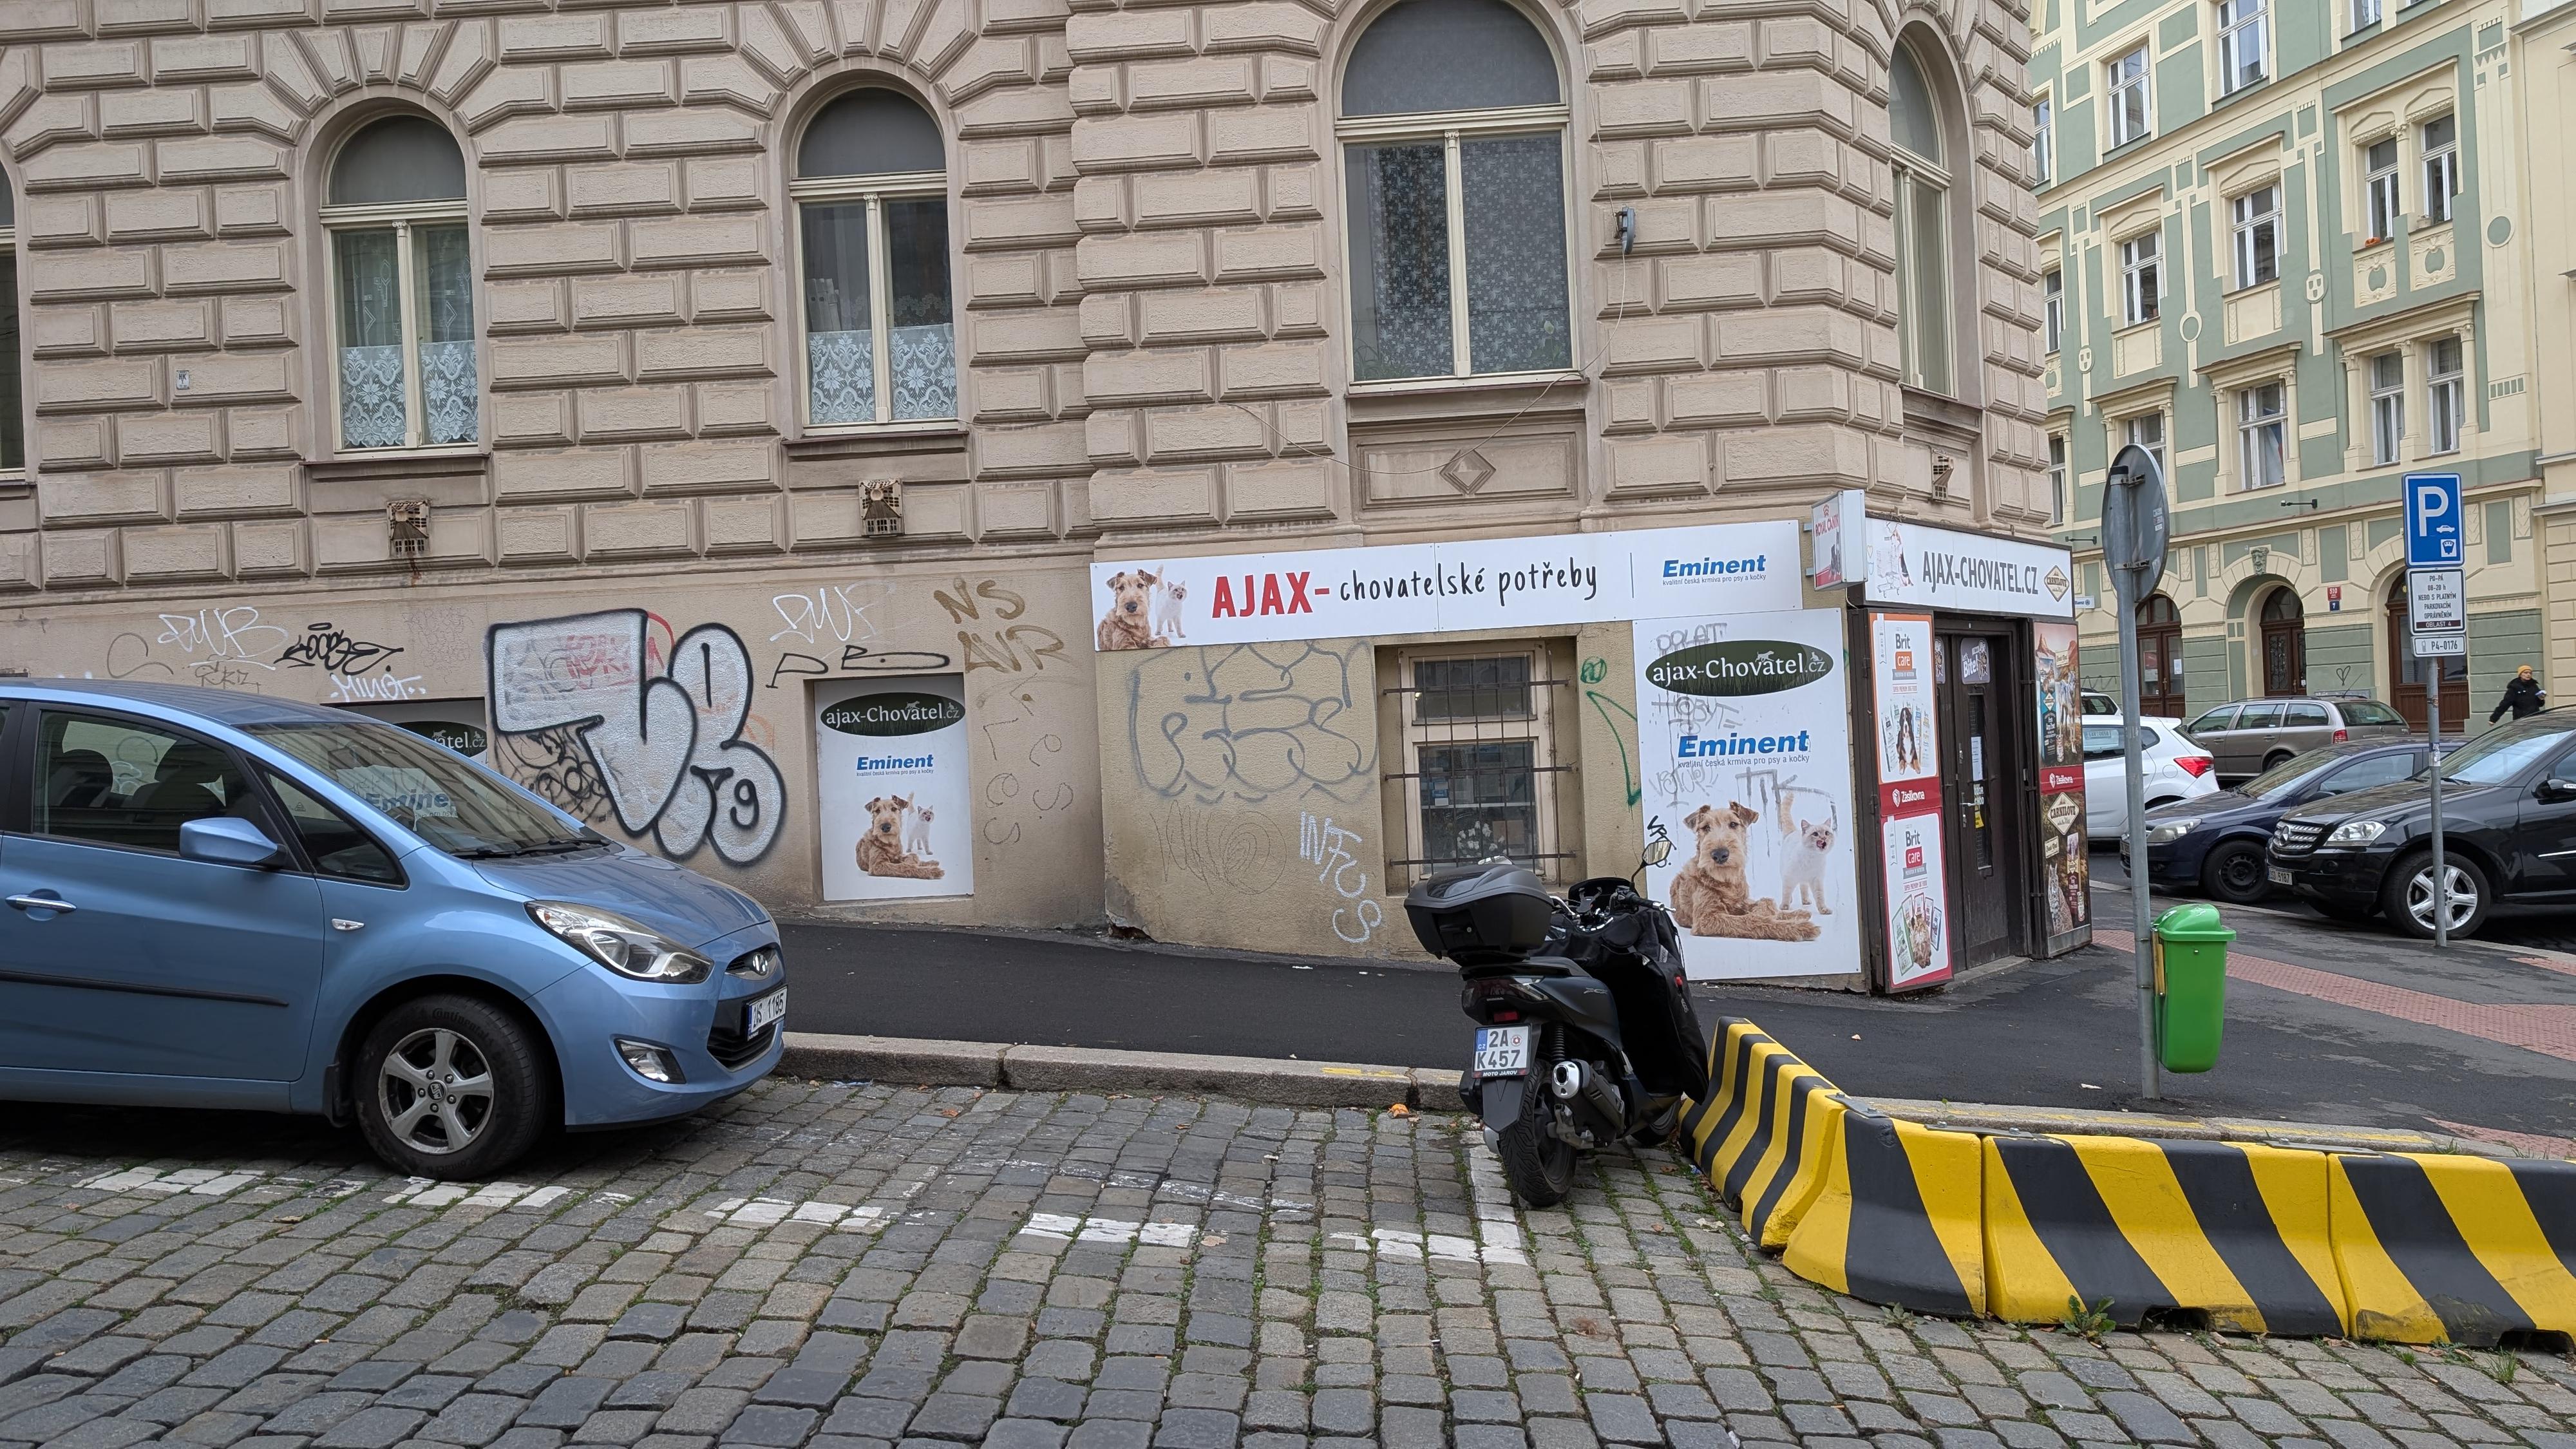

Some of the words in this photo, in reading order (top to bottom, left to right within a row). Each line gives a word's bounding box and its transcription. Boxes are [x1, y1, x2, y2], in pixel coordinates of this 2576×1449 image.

[2418, 486, 2448, 537] P
[1815, 520, 1827, 537] ROYAL
[1663, 555, 1766, 578] Eminent
[1922, 551, 2038, 594] AJAX-CHOVATEL.CZ
[2429, 573, 2444, 582] PO-PÁ
[1211, 571, 1330, 618] AJAX-
[1340, 562, 1485, 601] chovatelské
[1499, 557, 1596, 607] potřeby
[2436, 591, 2457, 600] PLATNÝM
[2424, 601, 2451, 610] PARKOVACÍM
[2424, 611, 2452, 619] OPRÁVNĚNÍM
[1895, 633, 1911, 649] Brit
[2431, 640, 2458, 650] P4-0176
[1653, 652, 1826, 687] ajax-Chovatel.cz
[1897, 655, 1911, 667] care
[826, 703, 960, 728] ajax-Chovatel.cz
[1678, 730, 1810, 758] Eminent
[857, 754, 934, 770] Eminent
[1705, 759, 1725, 767] česká
[1789, 754, 1810, 763] kočky
[2050, 806, 2076, 820] CARNILOVE
[1905, 829, 1921, 847] Brit
[1908, 851, 1920, 864] care
[768, 992, 784, 1019] 1185
[1489, 1030, 1508, 1048] 2A
[1477, 1050, 1520, 1069] K457
